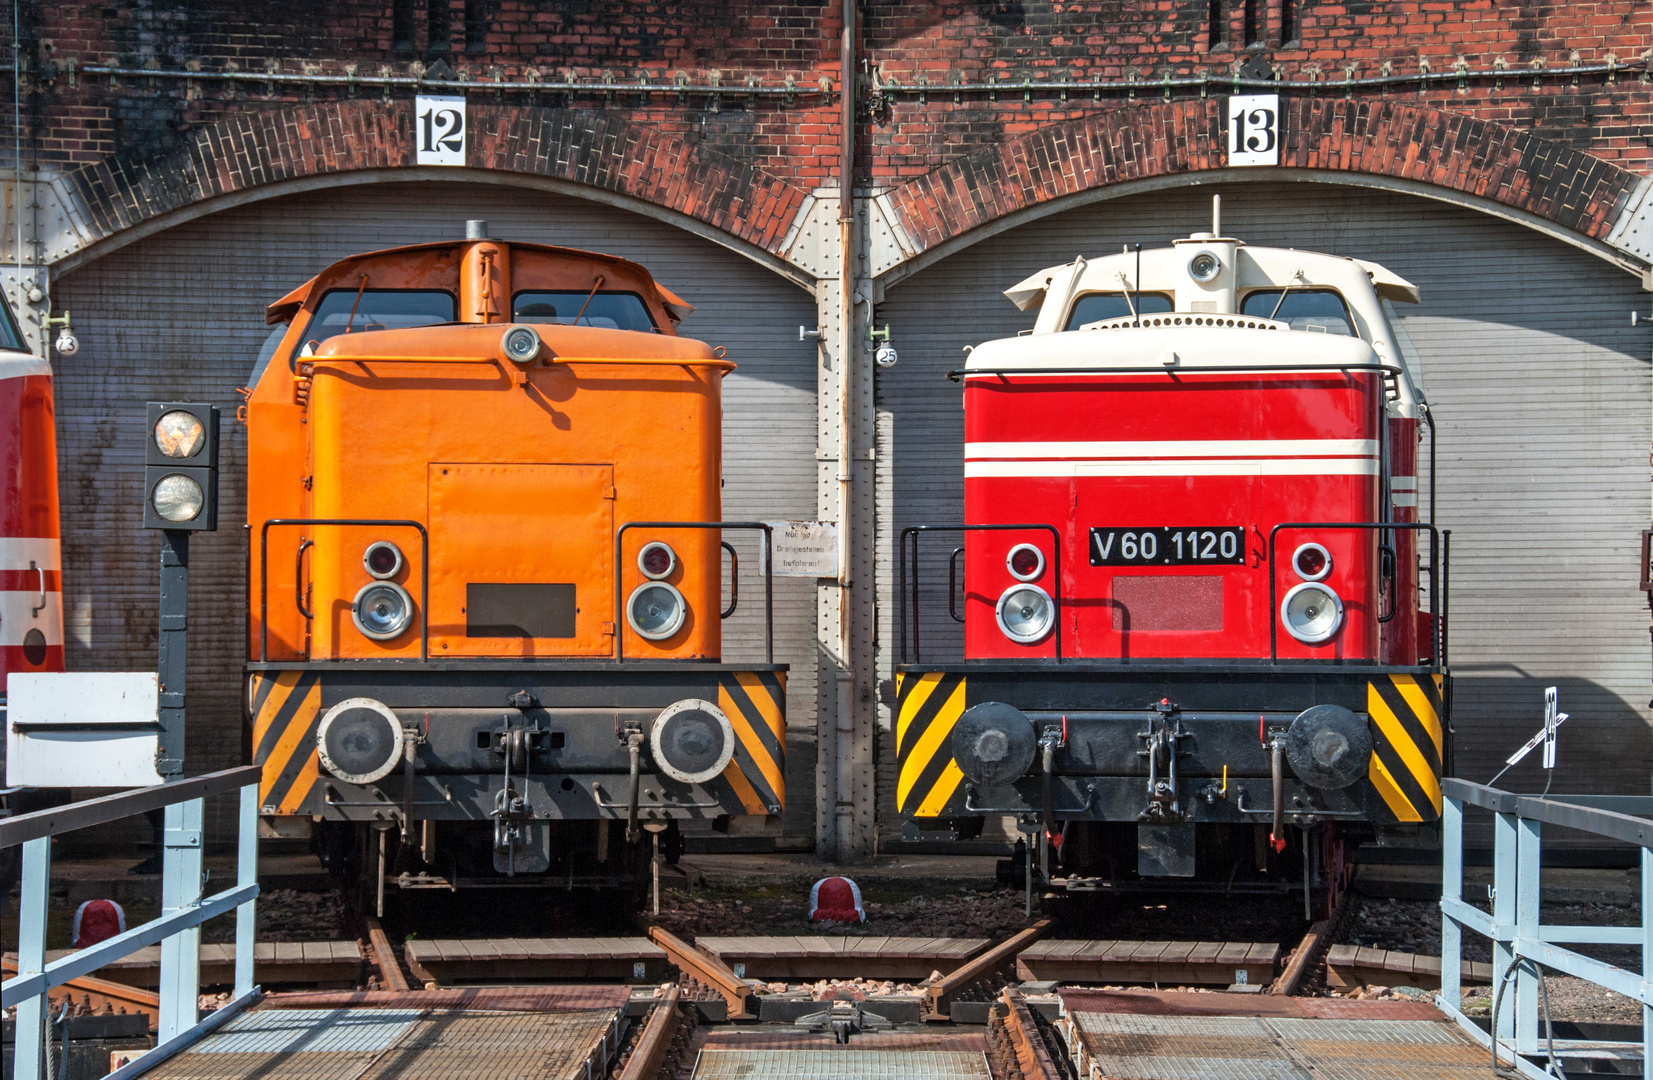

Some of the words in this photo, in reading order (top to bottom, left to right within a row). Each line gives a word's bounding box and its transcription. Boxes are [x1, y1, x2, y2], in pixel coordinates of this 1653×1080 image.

[419, 107, 463, 153] 12
[1231, 108, 1276, 154] 13
[880, 350, 896, 363] 25
[155, 420, 203, 457] W
[1093, 532, 1115, 560] V
[1121, 532, 1157, 560] 60
[1171, 531, 1237, 559] 1120
